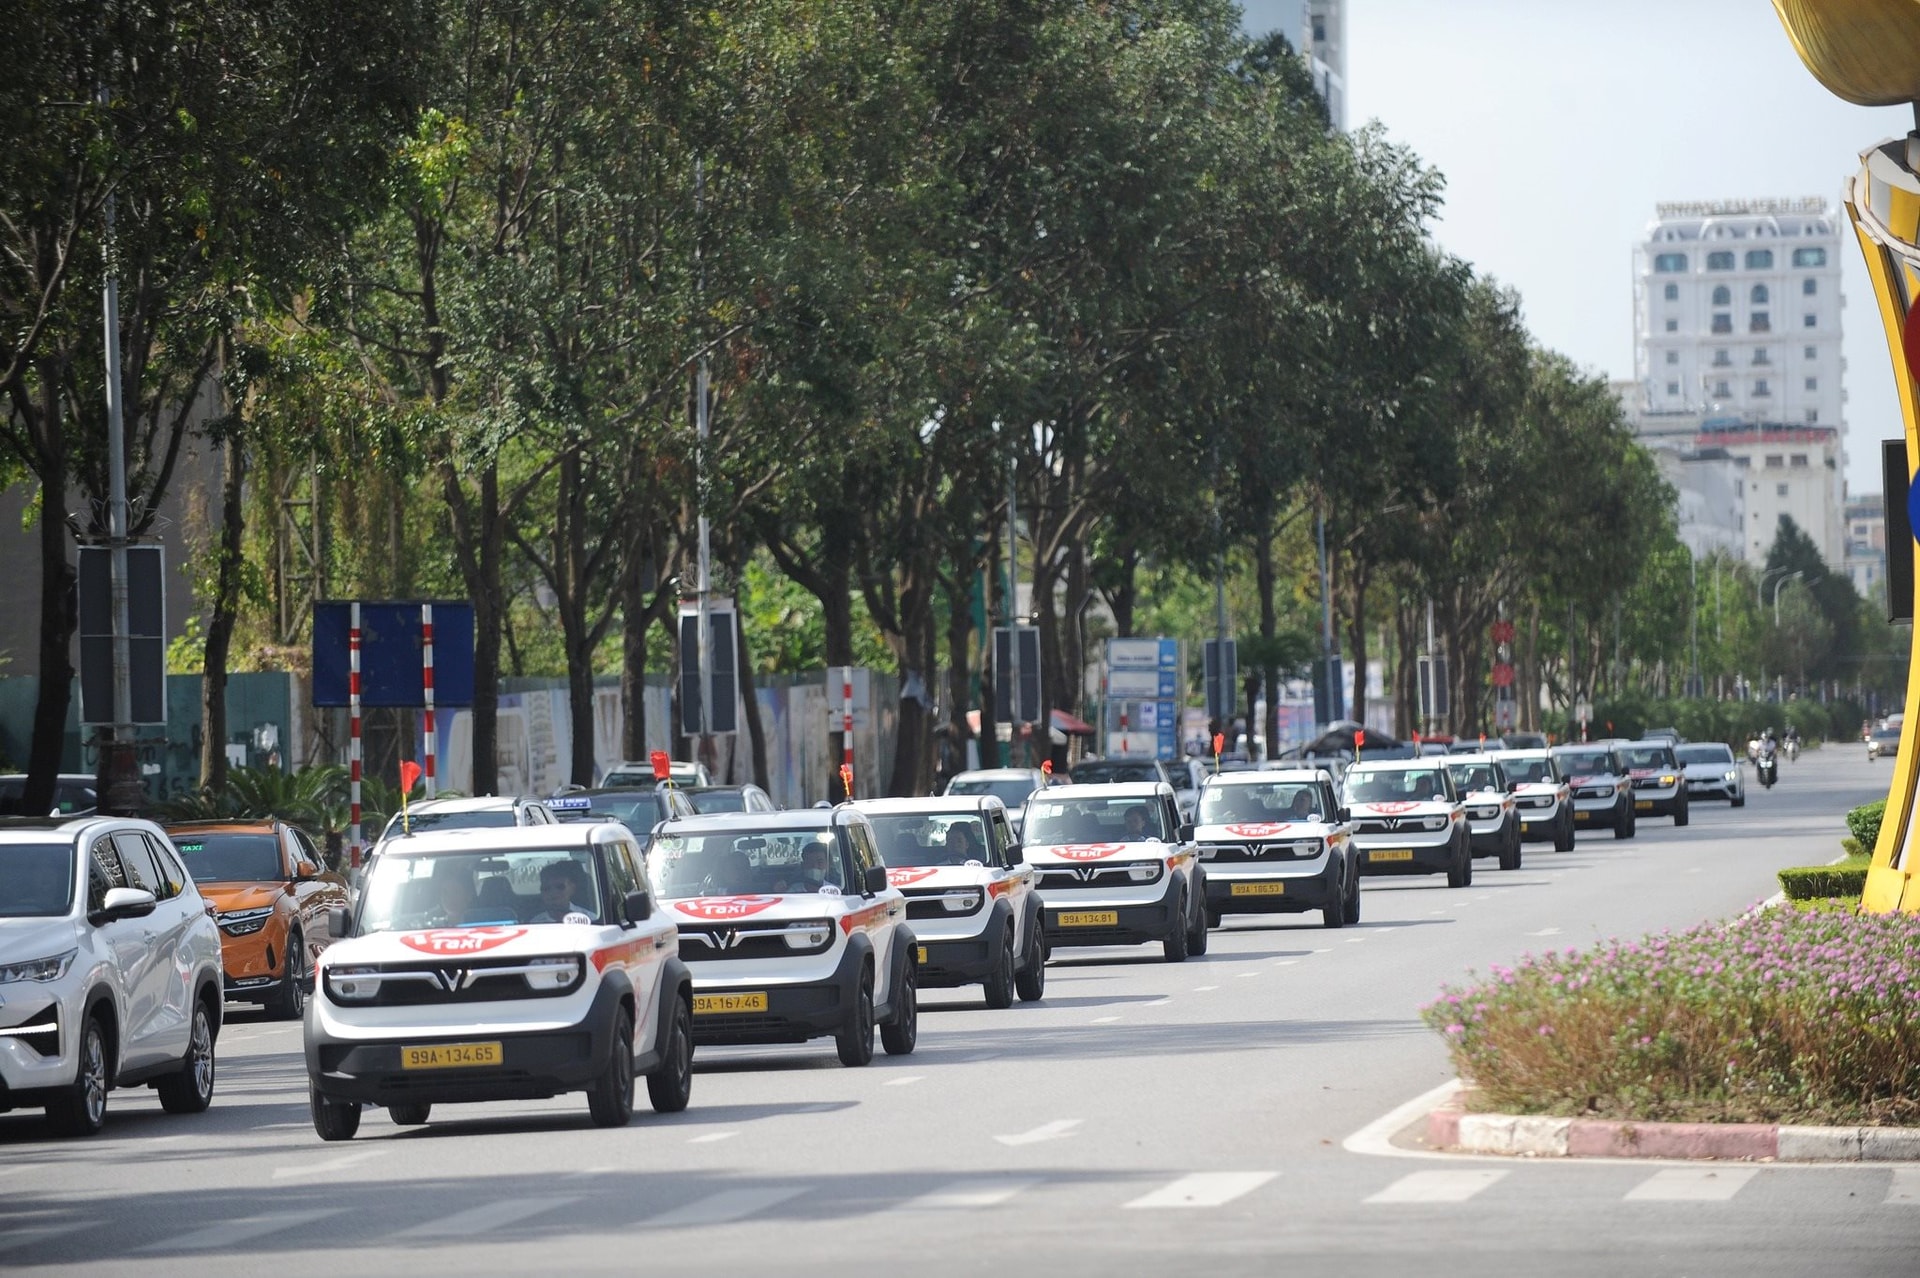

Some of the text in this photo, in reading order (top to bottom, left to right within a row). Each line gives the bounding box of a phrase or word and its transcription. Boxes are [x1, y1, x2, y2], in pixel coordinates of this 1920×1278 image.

[702, 904, 747, 915] Taxi
[431, 937, 484, 950] Taxi
[411, 1047, 493, 1064] 99A-134.65
